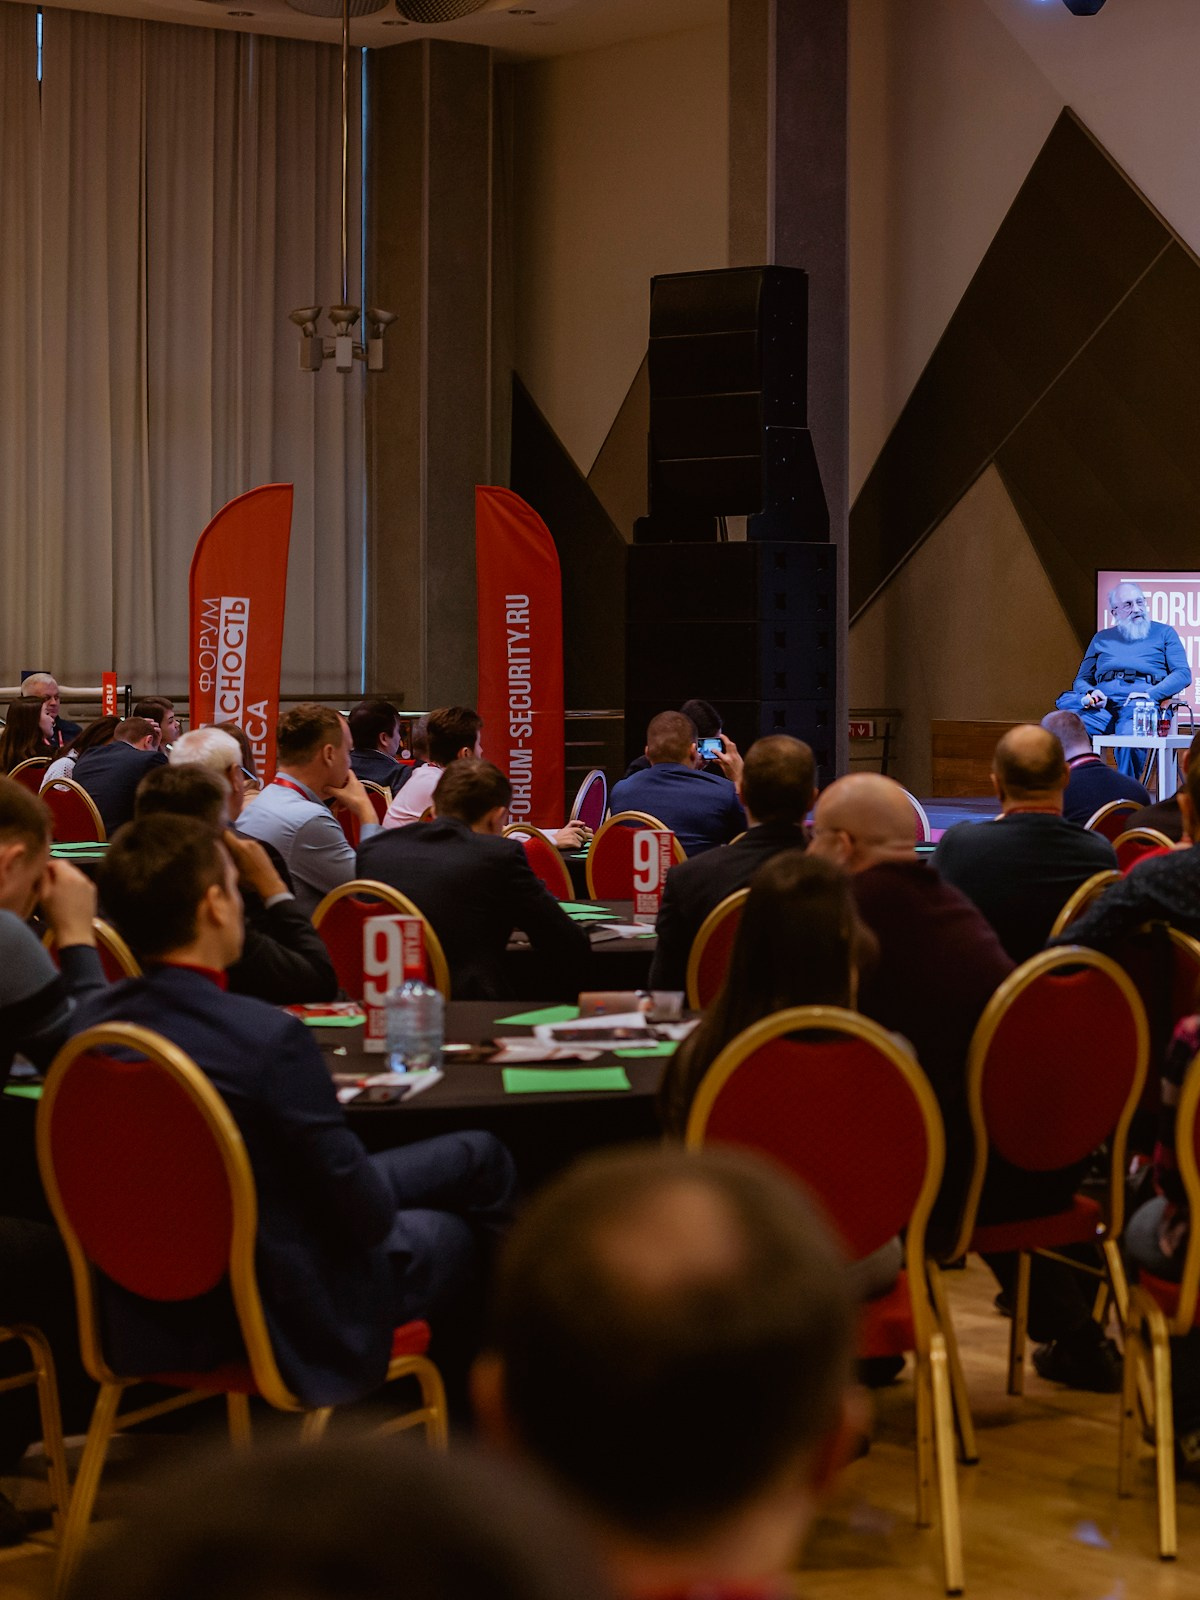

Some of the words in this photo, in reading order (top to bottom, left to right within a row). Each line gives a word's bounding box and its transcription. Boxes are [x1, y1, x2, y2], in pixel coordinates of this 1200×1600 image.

[198, 597, 221, 693] ФОРУМ
[505, 594, 533, 826] FORUM-SECURITY.RU
[633, 831, 659, 892] 9
[363, 920, 403, 1007] 9
